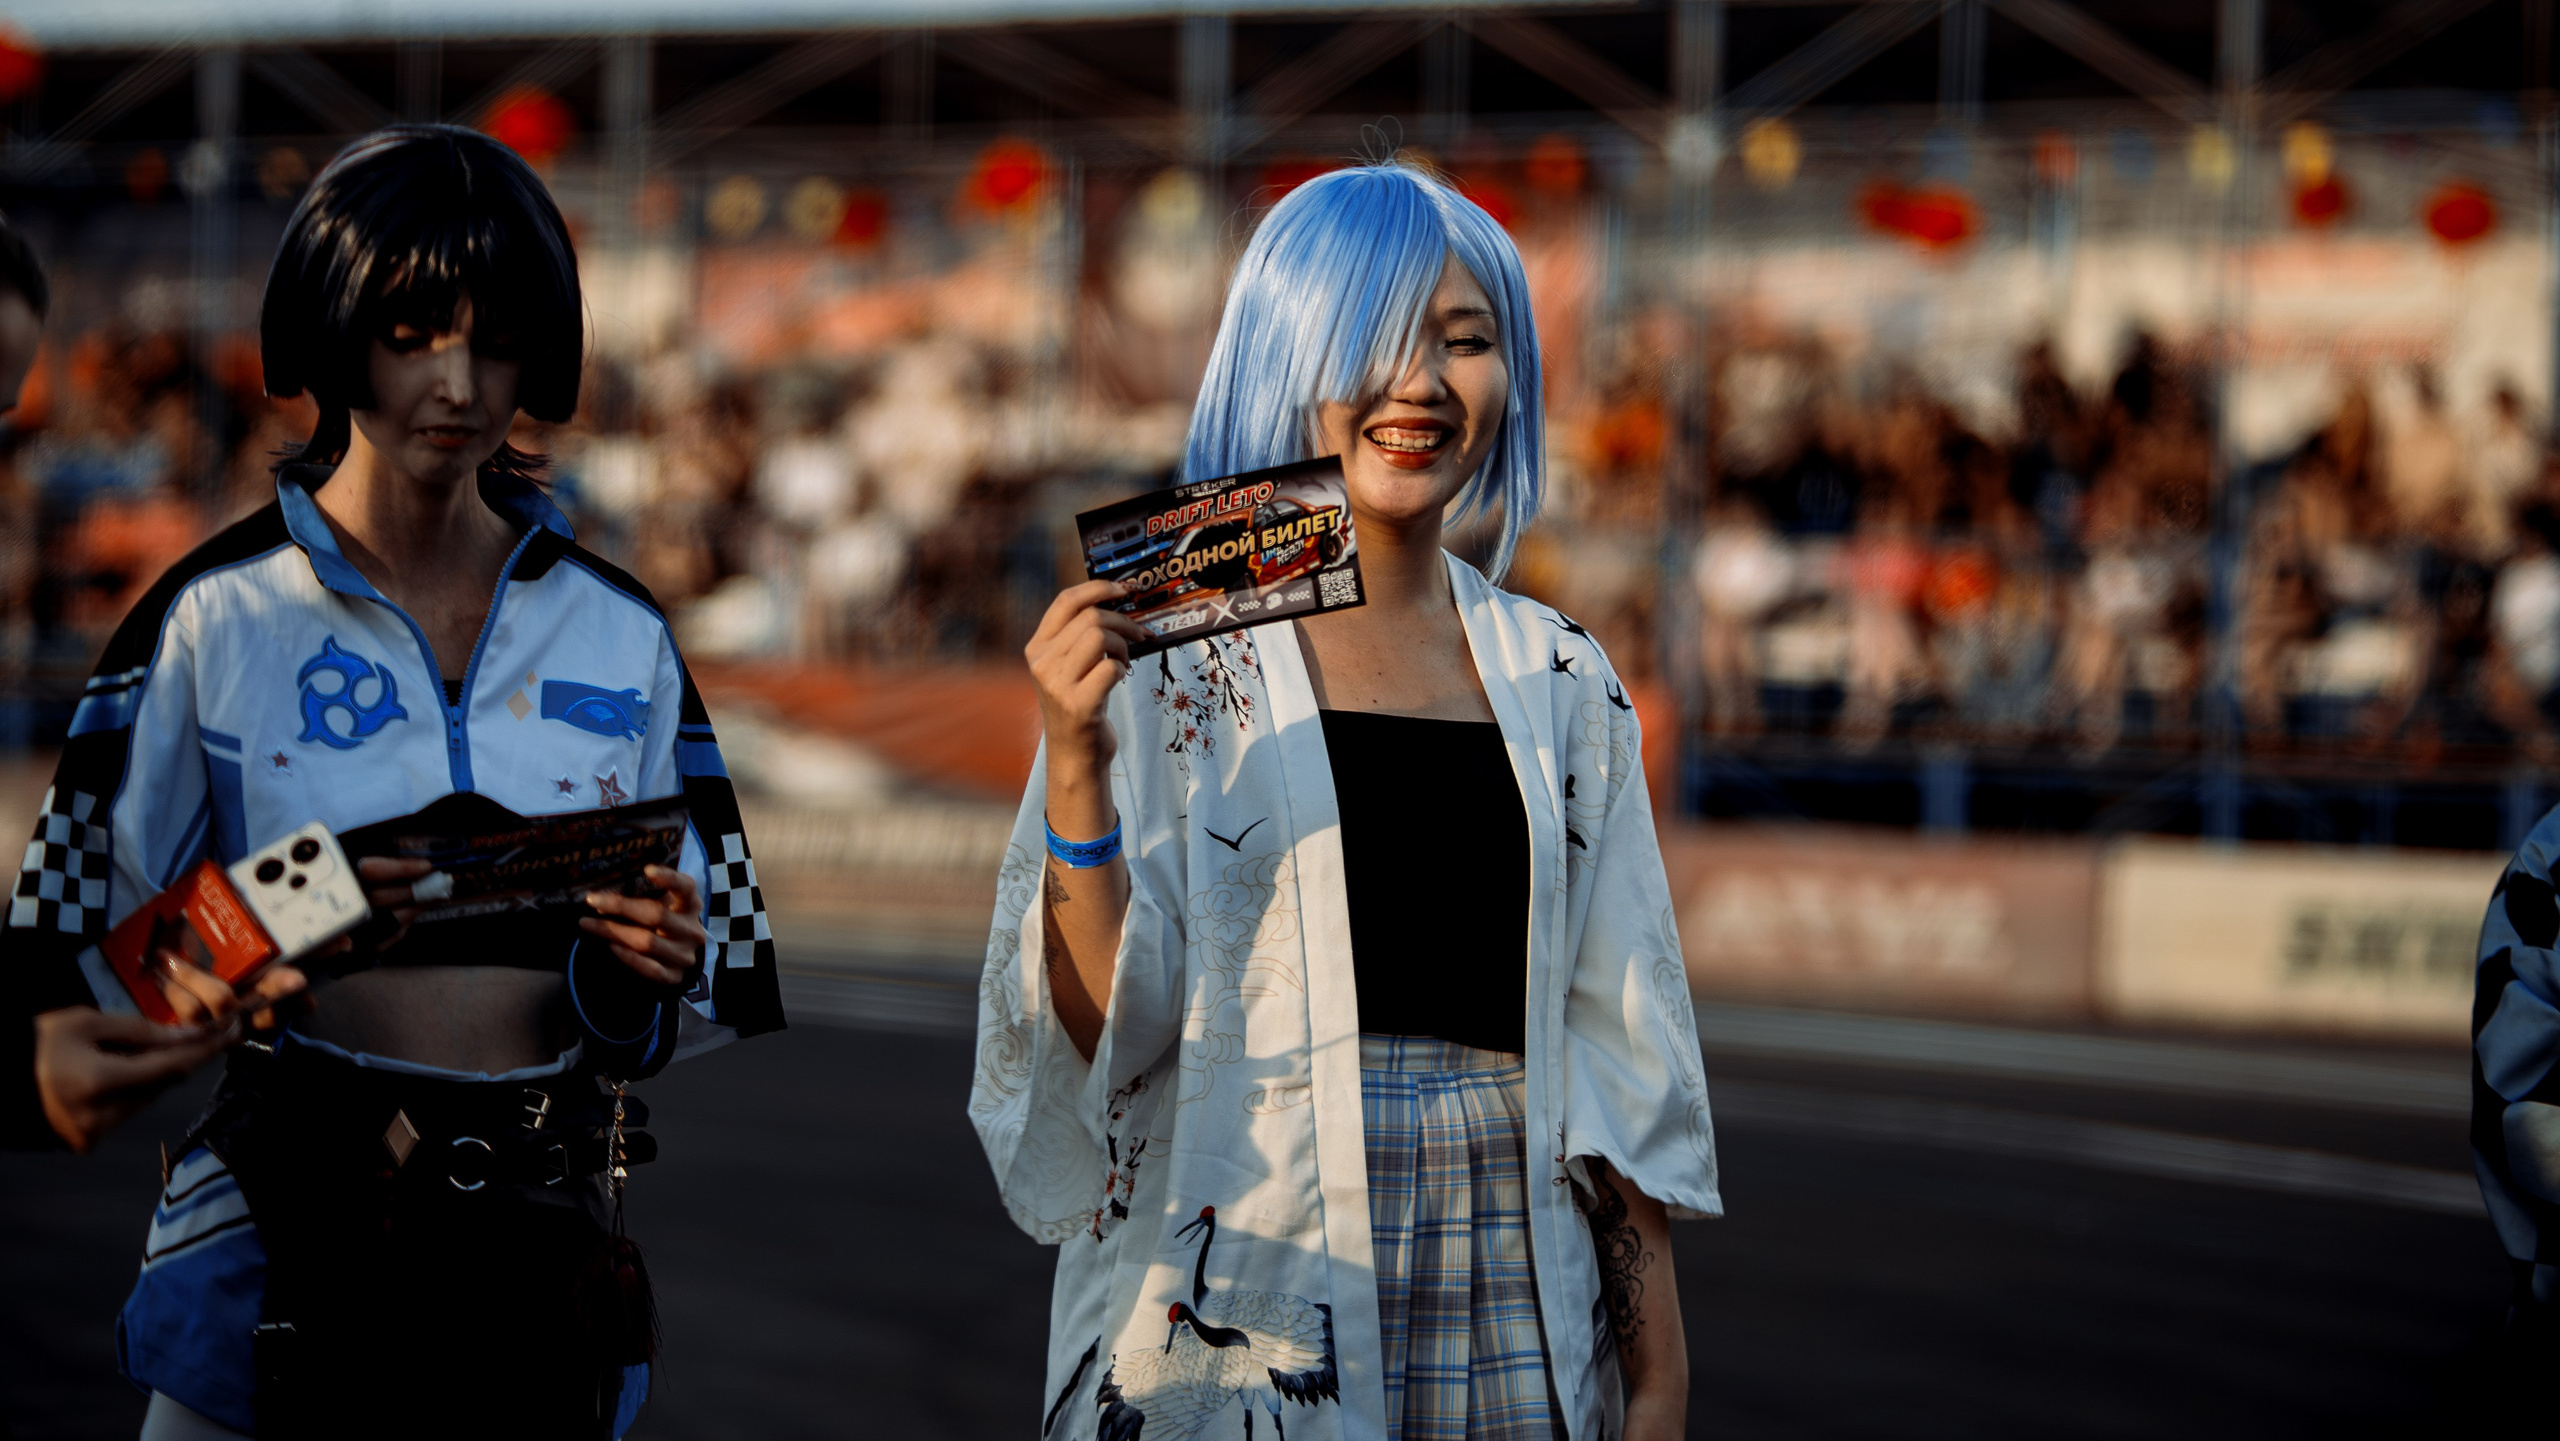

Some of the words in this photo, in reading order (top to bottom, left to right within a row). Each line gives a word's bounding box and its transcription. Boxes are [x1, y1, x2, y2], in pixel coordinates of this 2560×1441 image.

[1145, 500, 1213, 538] DRIFT
[1216, 480, 1276, 515] LETO
[1175, 478, 1237, 498] STROKER
[1128, 531, 1256, 592] ОХОДНОЙ
[1261, 508, 1341, 548] БИЛЕТ
